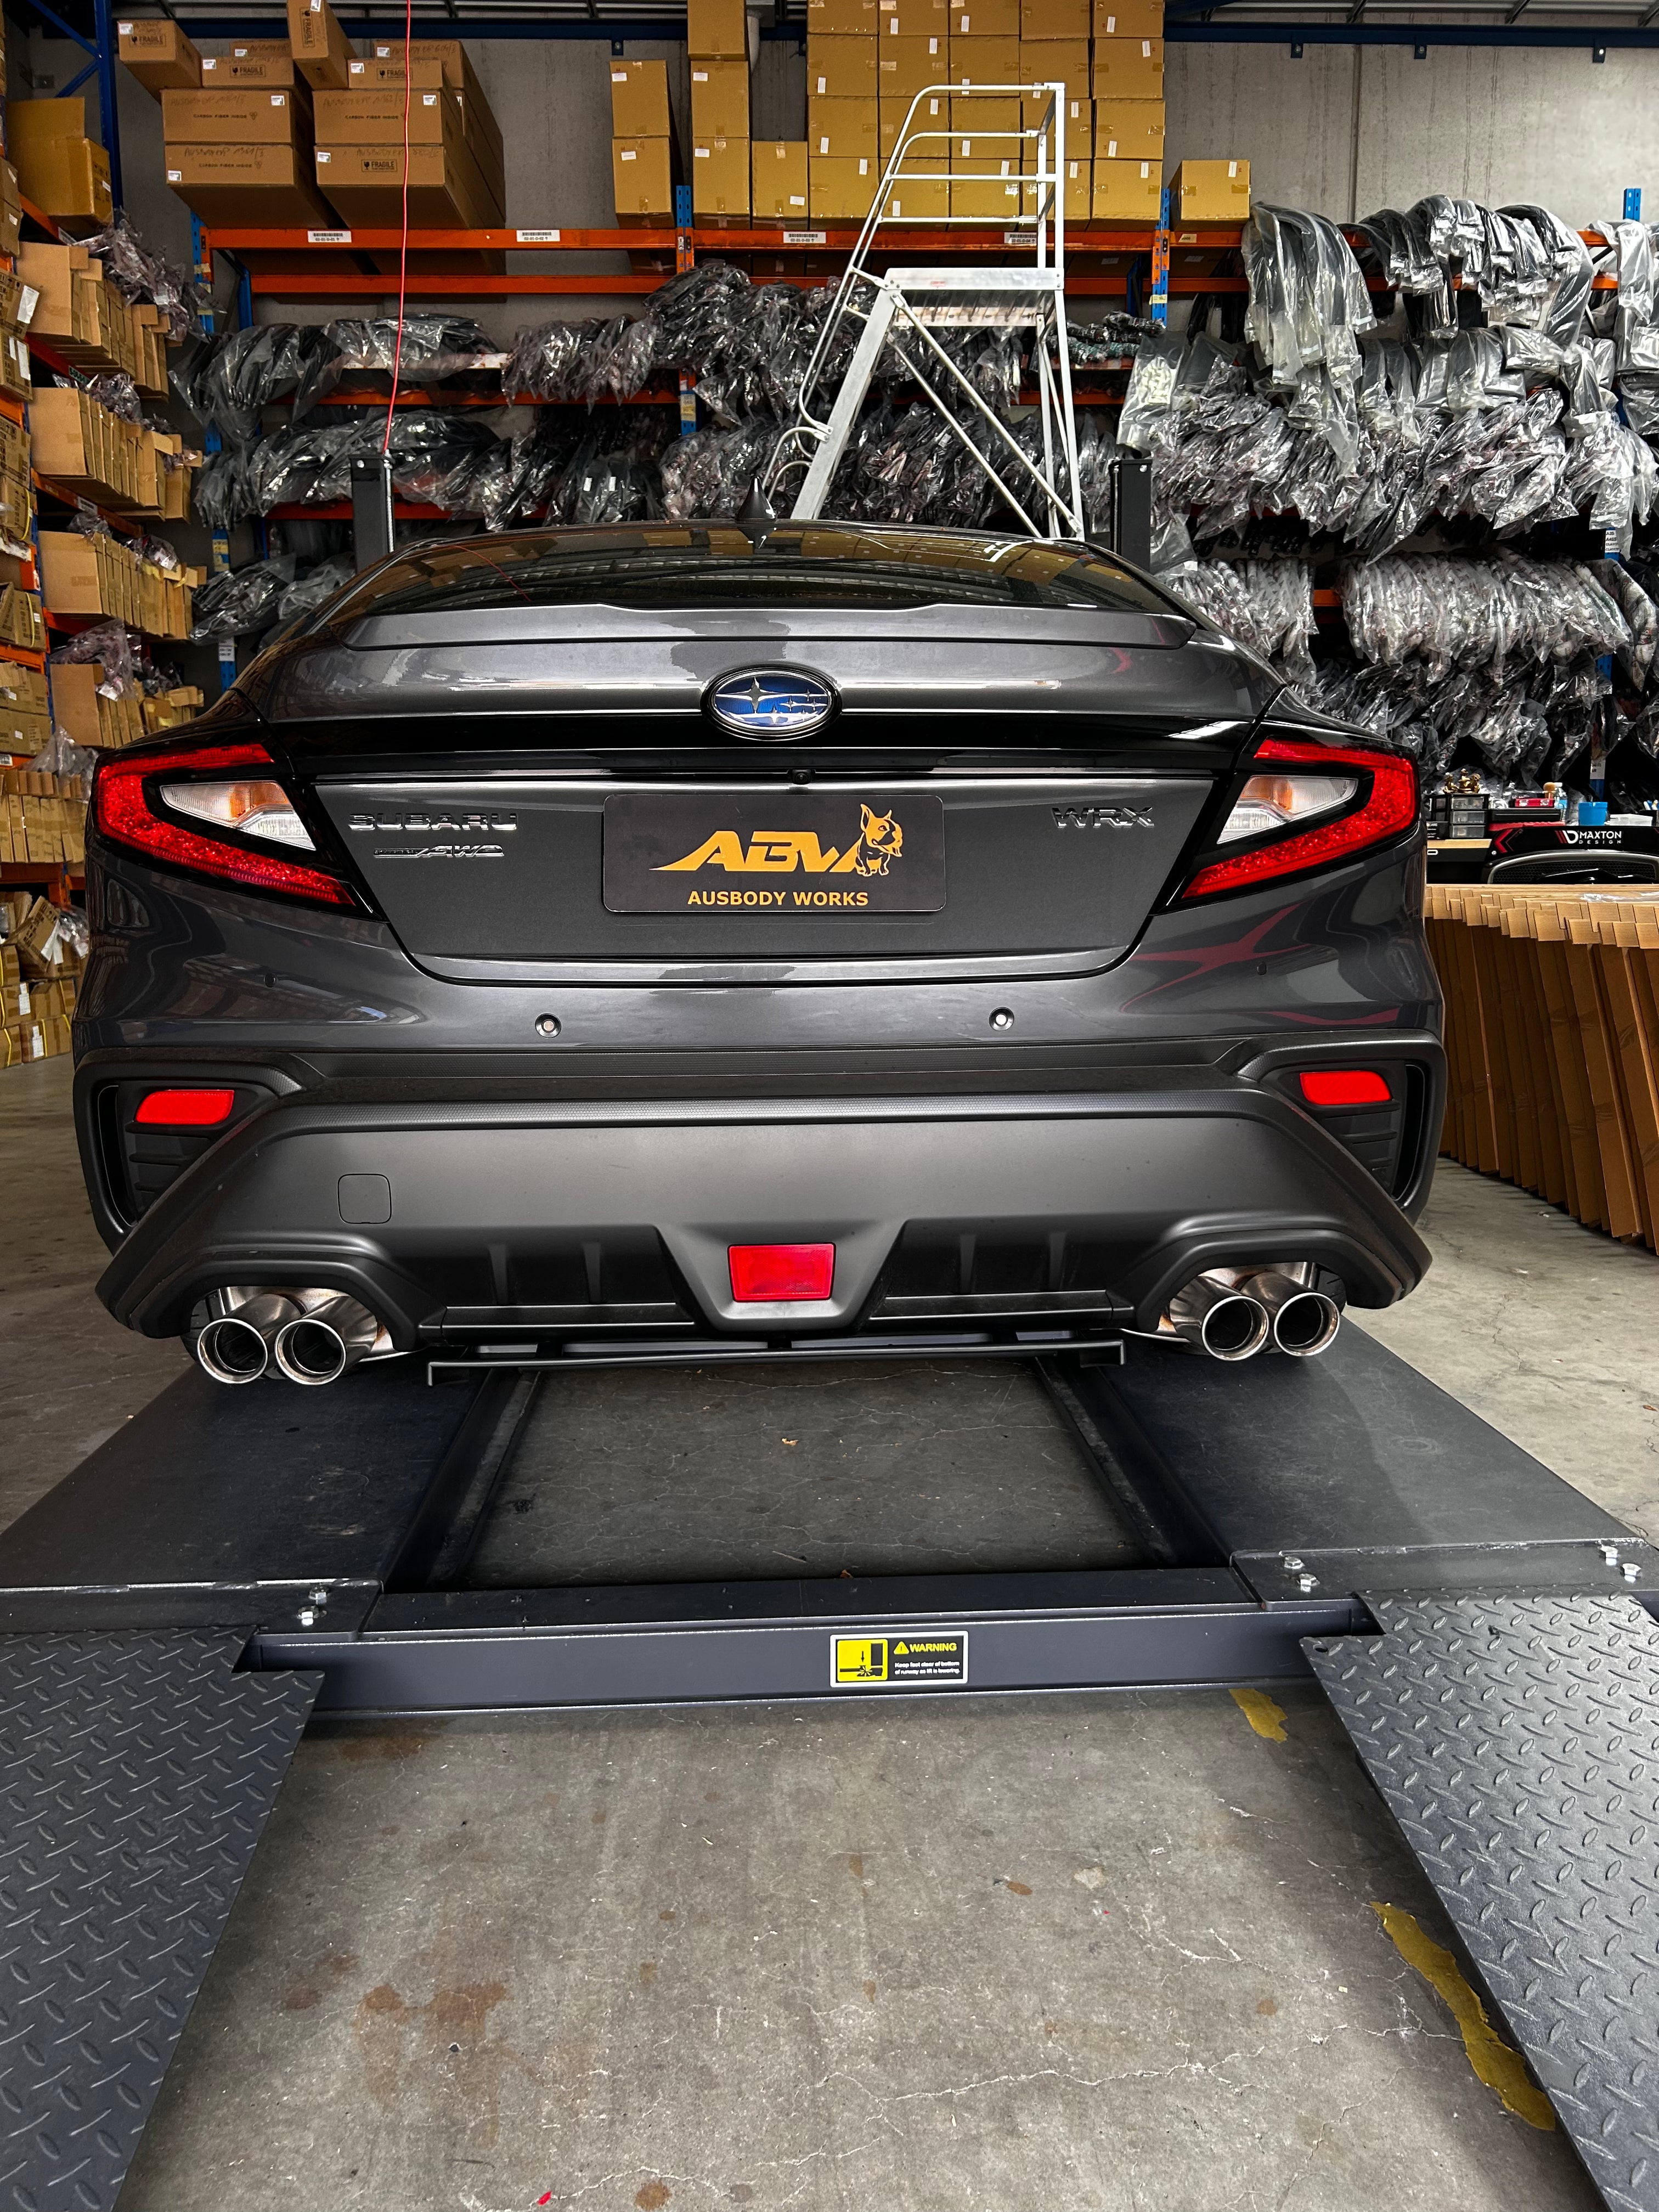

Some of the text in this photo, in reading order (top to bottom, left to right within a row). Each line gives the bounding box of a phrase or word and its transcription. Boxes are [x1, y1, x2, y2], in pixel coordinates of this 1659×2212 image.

[347, 812, 518, 831] SUBARU
[1051, 806, 1155, 829] WRX
[1579, 831, 1622, 839] MAXTON
[420, 844, 505, 858] AWD
[687, 891, 868, 906] AUSBODY WORKS
[910, 1643, 957, 1652] WARNING
